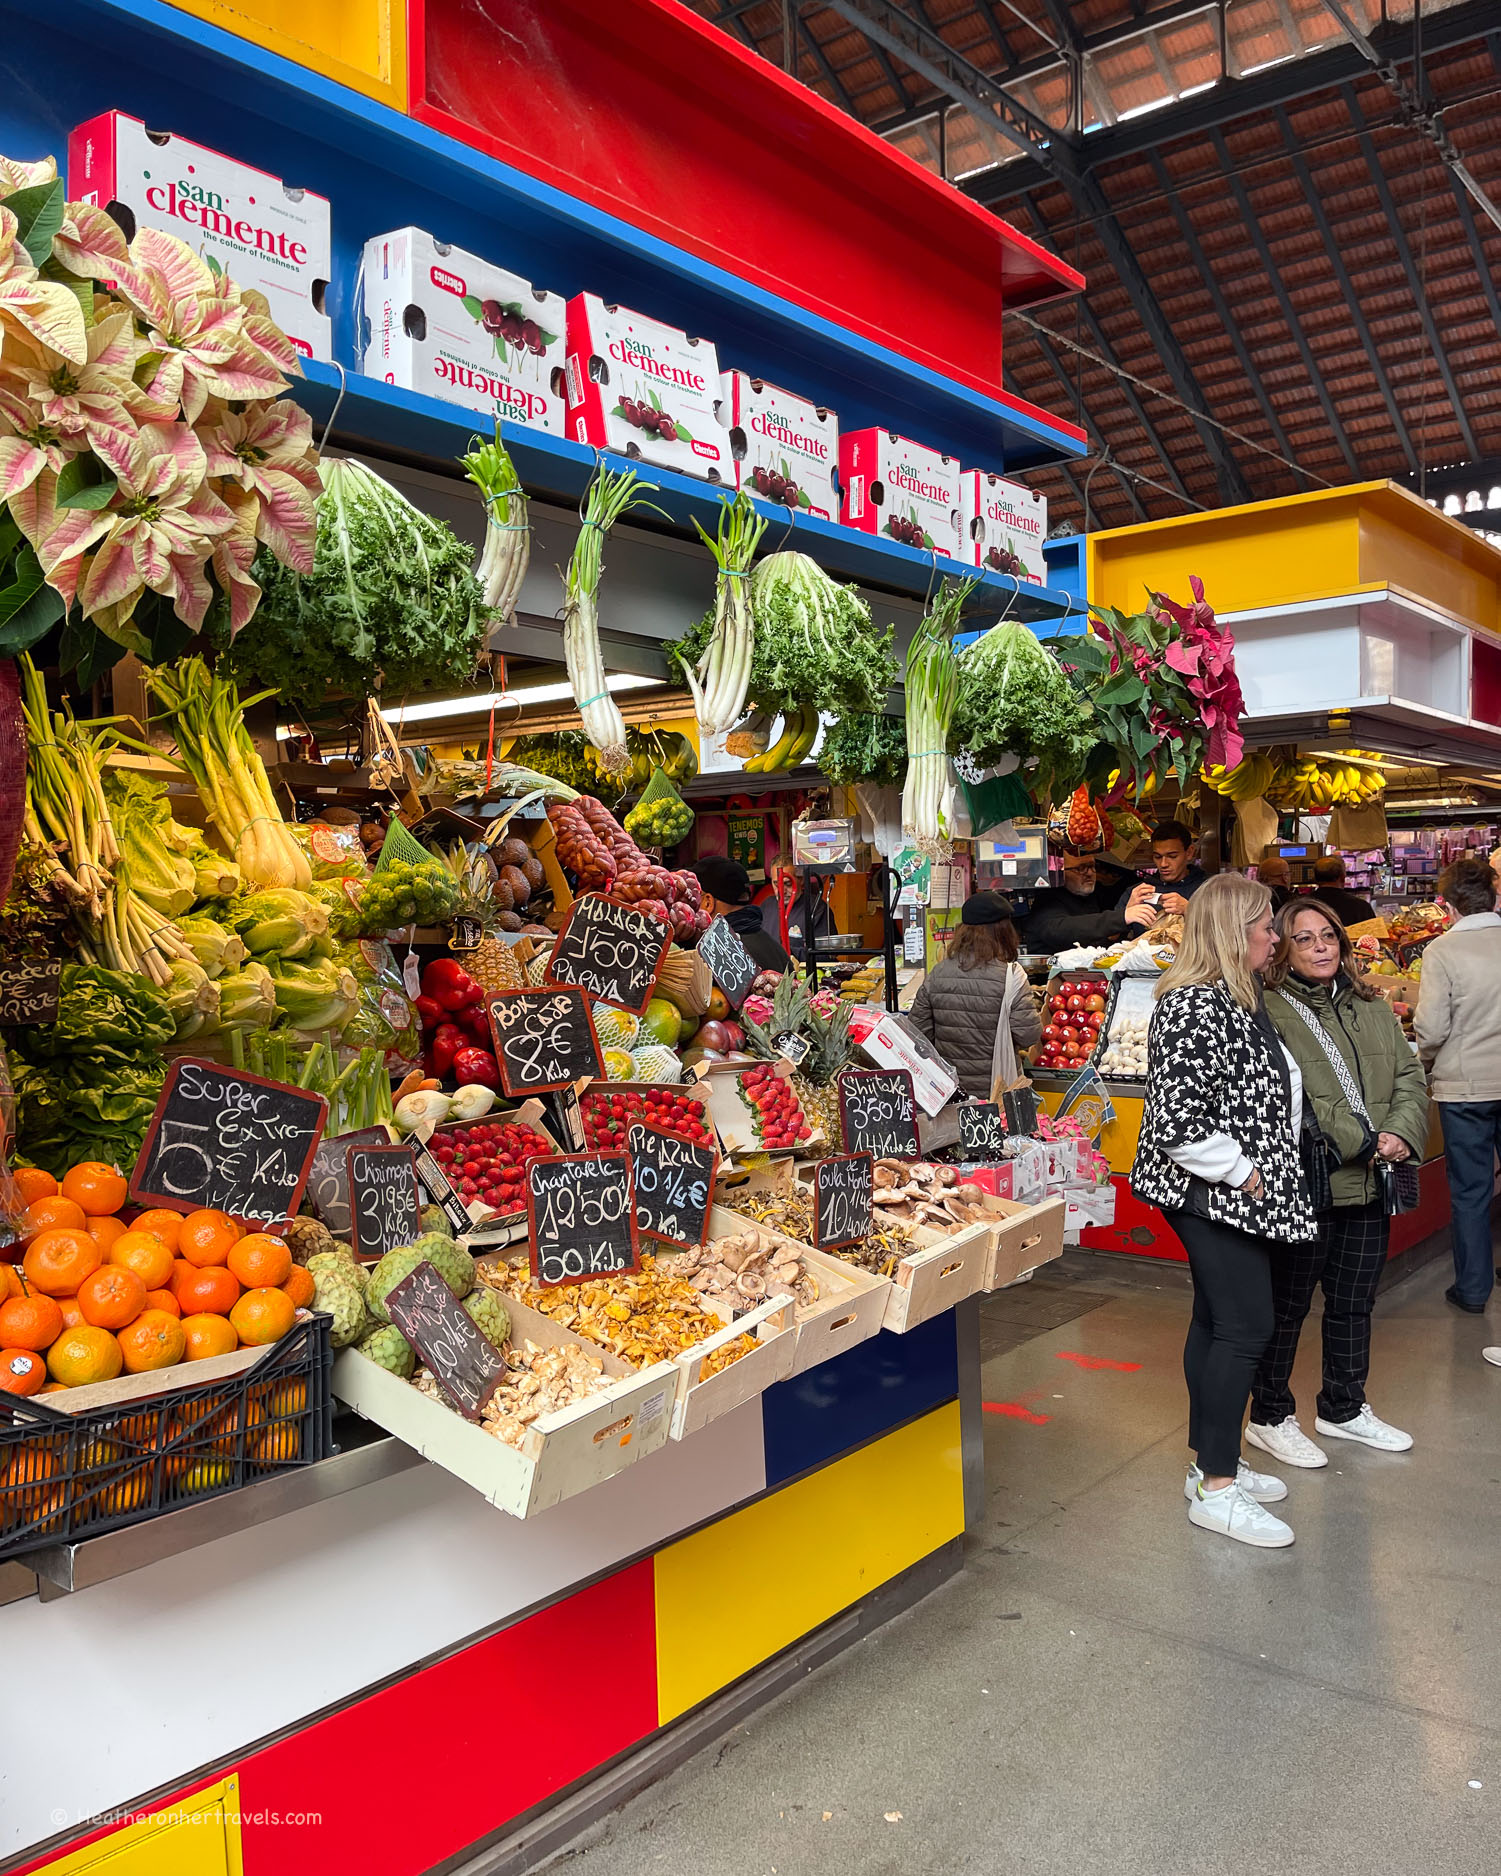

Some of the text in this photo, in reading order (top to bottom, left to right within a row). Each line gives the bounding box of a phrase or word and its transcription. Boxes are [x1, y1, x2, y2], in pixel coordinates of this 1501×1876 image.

[177, 180, 223, 211] san
[146, 183, 307, 265] clemente
[203, 230, 300, 273] the colour of freshness
[433, 270, 464, 293] Cherries
[624, 337, 652, 358] san
[608, 340, 706, 391] clemente
[434, 356, 547, 420] clemente
[495, 400, 527, 422] san
[766, 410, 789, 429] san
[751, 413, 828, 459] clemente
[888, 466, 950, 503] clemente
[900, 463, 917, 478] san
[988, 502, 1040, 534] clemente
[998, 500, 1013, 513] san
[728, 818, 763, 842] TENEMOS
[551, 958, 657, 1002] PAPAYA Kilo
[543, 1058, 571, 1083] Kilo
[178, 1064, 270, 1113] Super
[628, 1123, 655, 1153] Pie
[965, 1123, 989, 1148] 20
[251, 1148, 300, 1187] Kilo
[632, 1155, 658, 1193] 10
[385, 1211, 409, 1236] Kilo
[657, 1211, 686, 1242] Kilo
[819, 1191, 849, 1242] 10
[540, 1240, 625, 1283] 50 Kilo
